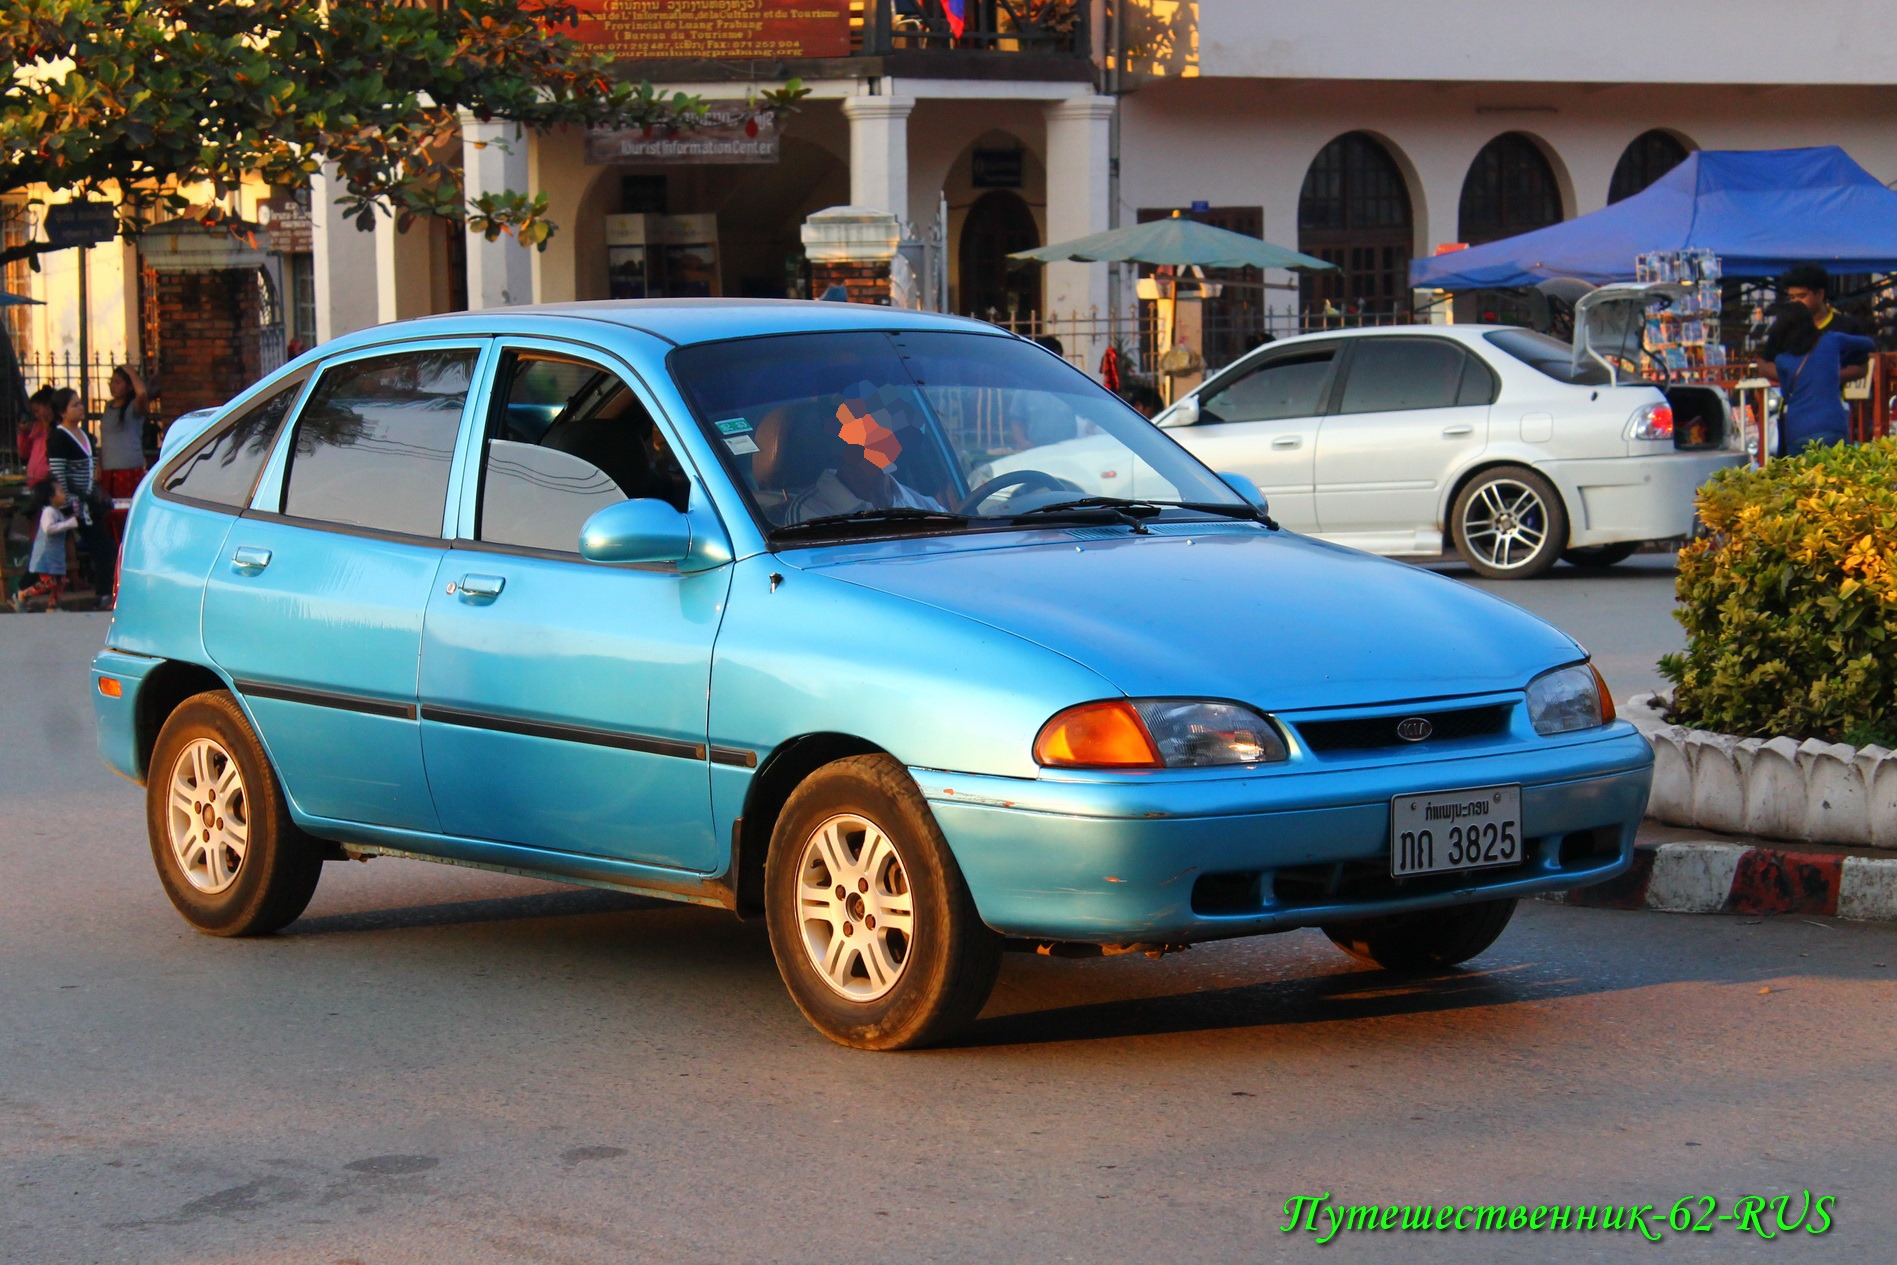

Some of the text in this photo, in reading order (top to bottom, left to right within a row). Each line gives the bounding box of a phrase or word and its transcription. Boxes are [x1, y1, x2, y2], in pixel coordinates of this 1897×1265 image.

[774, 10, 788, 18] du
[791, 9, 840, 18] Tourisme
[604, 20, 763, 30] Provincial de Luang Prabang
[671, 31, 685, 39] du
[621, 139, 773, 155] Tourist Information Center
[1448, 820, 1516, 865] 3825
